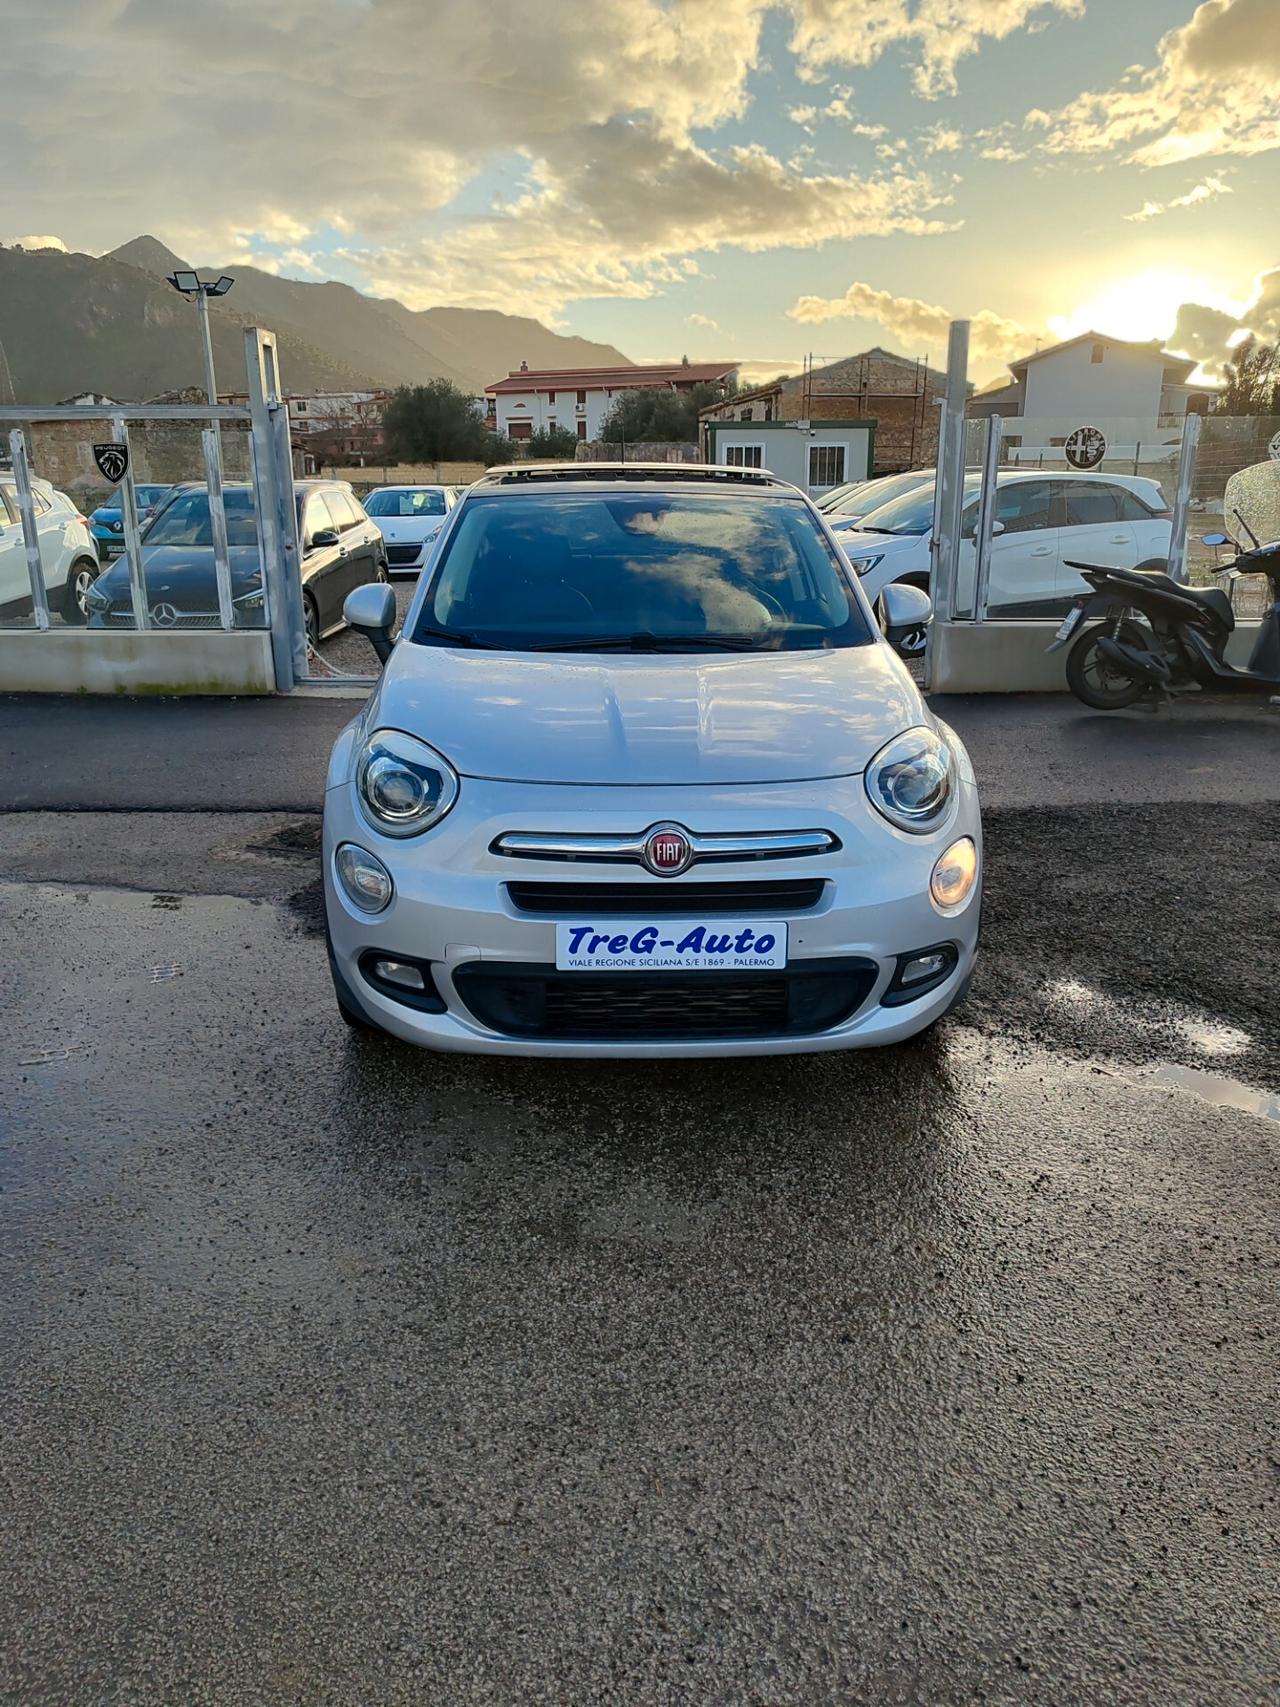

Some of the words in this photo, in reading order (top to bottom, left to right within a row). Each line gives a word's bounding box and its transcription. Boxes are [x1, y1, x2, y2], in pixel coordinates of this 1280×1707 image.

[656, 842, 680, 862] FIAT
[568, 925, 776, 955] TreG-Auto
[568, 958, 593, 967] VIALE
[595, 958, 637, 967] REGIONE
[639, 958, 683, 967] SICILIANA
[685, 958, 700, 967] S/E
[703, 958, 725, 967] 1869
[733, 958, 776, 967] PALERMO
